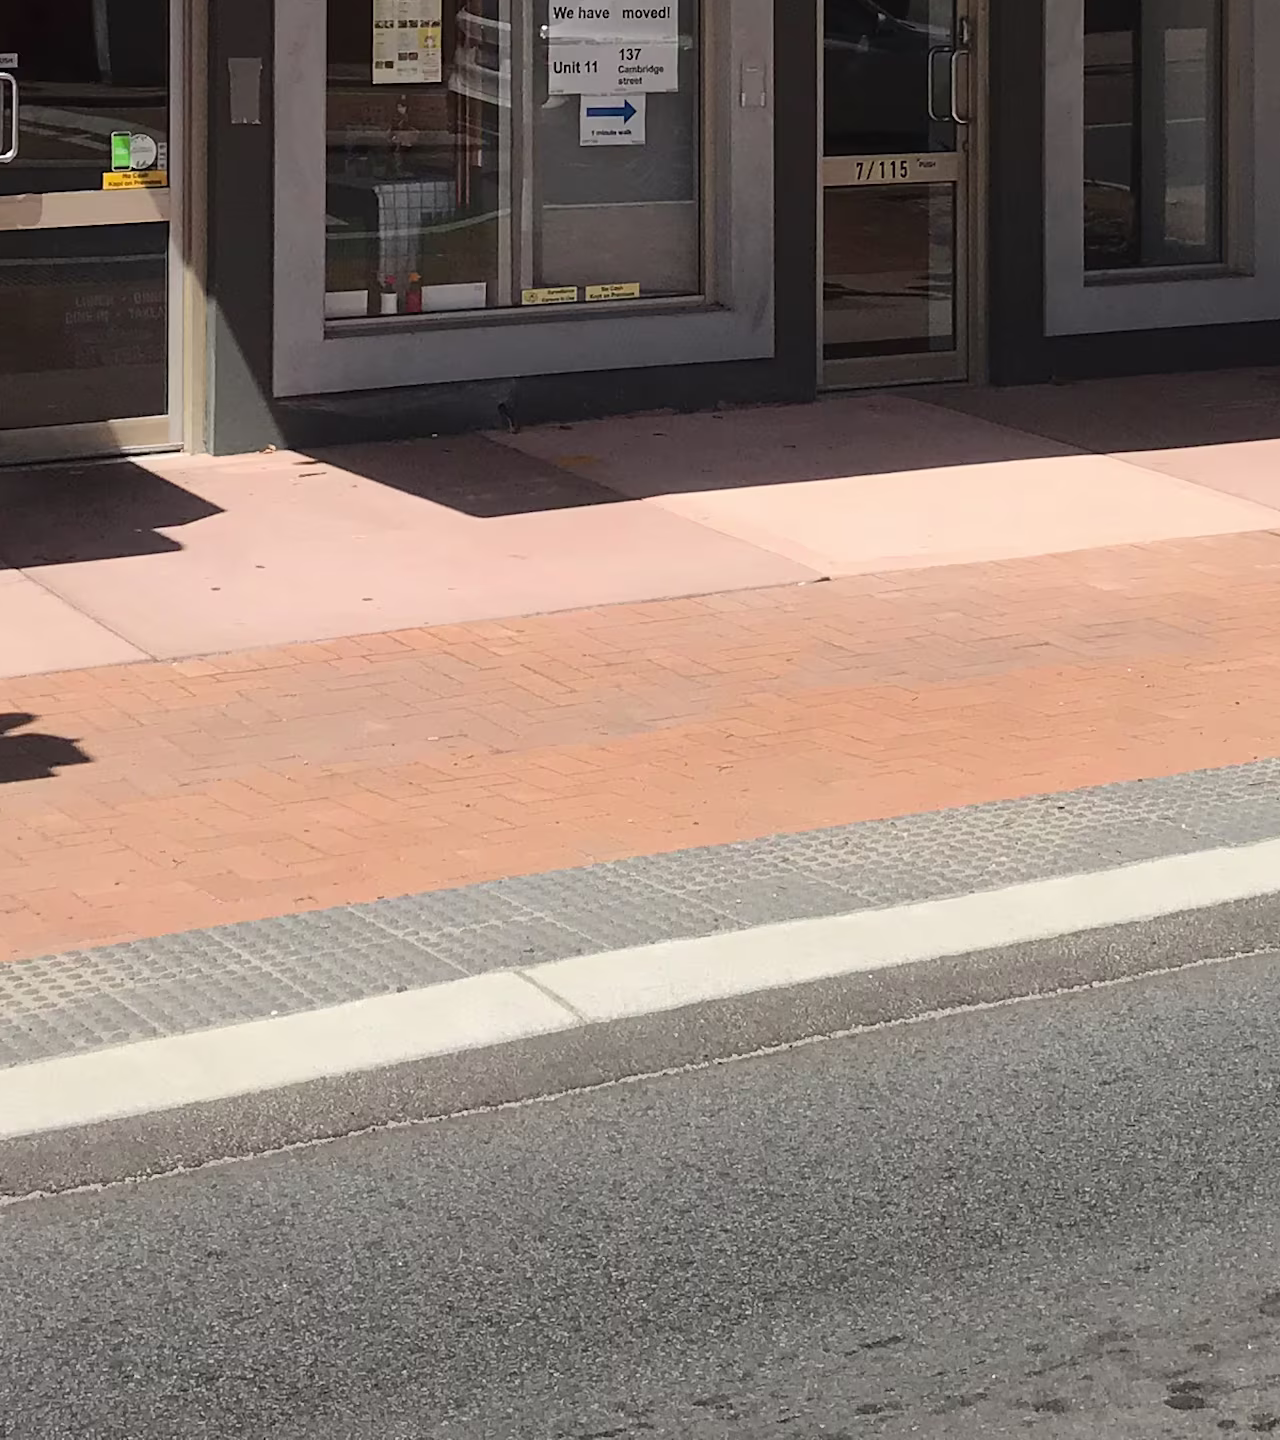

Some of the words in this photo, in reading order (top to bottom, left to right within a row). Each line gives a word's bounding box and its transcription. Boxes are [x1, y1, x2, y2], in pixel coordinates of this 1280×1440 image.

[553, 6, 574, 19] We
[578, 6, 610, 19] have
[622, 6, 671, 19] moved!
[618, 48, 642, 61] 137
[553, 61, 581, 74] Unit
[584, 60, 598, 73] 11
[617, 64, 664, 75] Cambridge
[617, 77, 643, 86] street
[856, 160, 908, 180] 7/115
